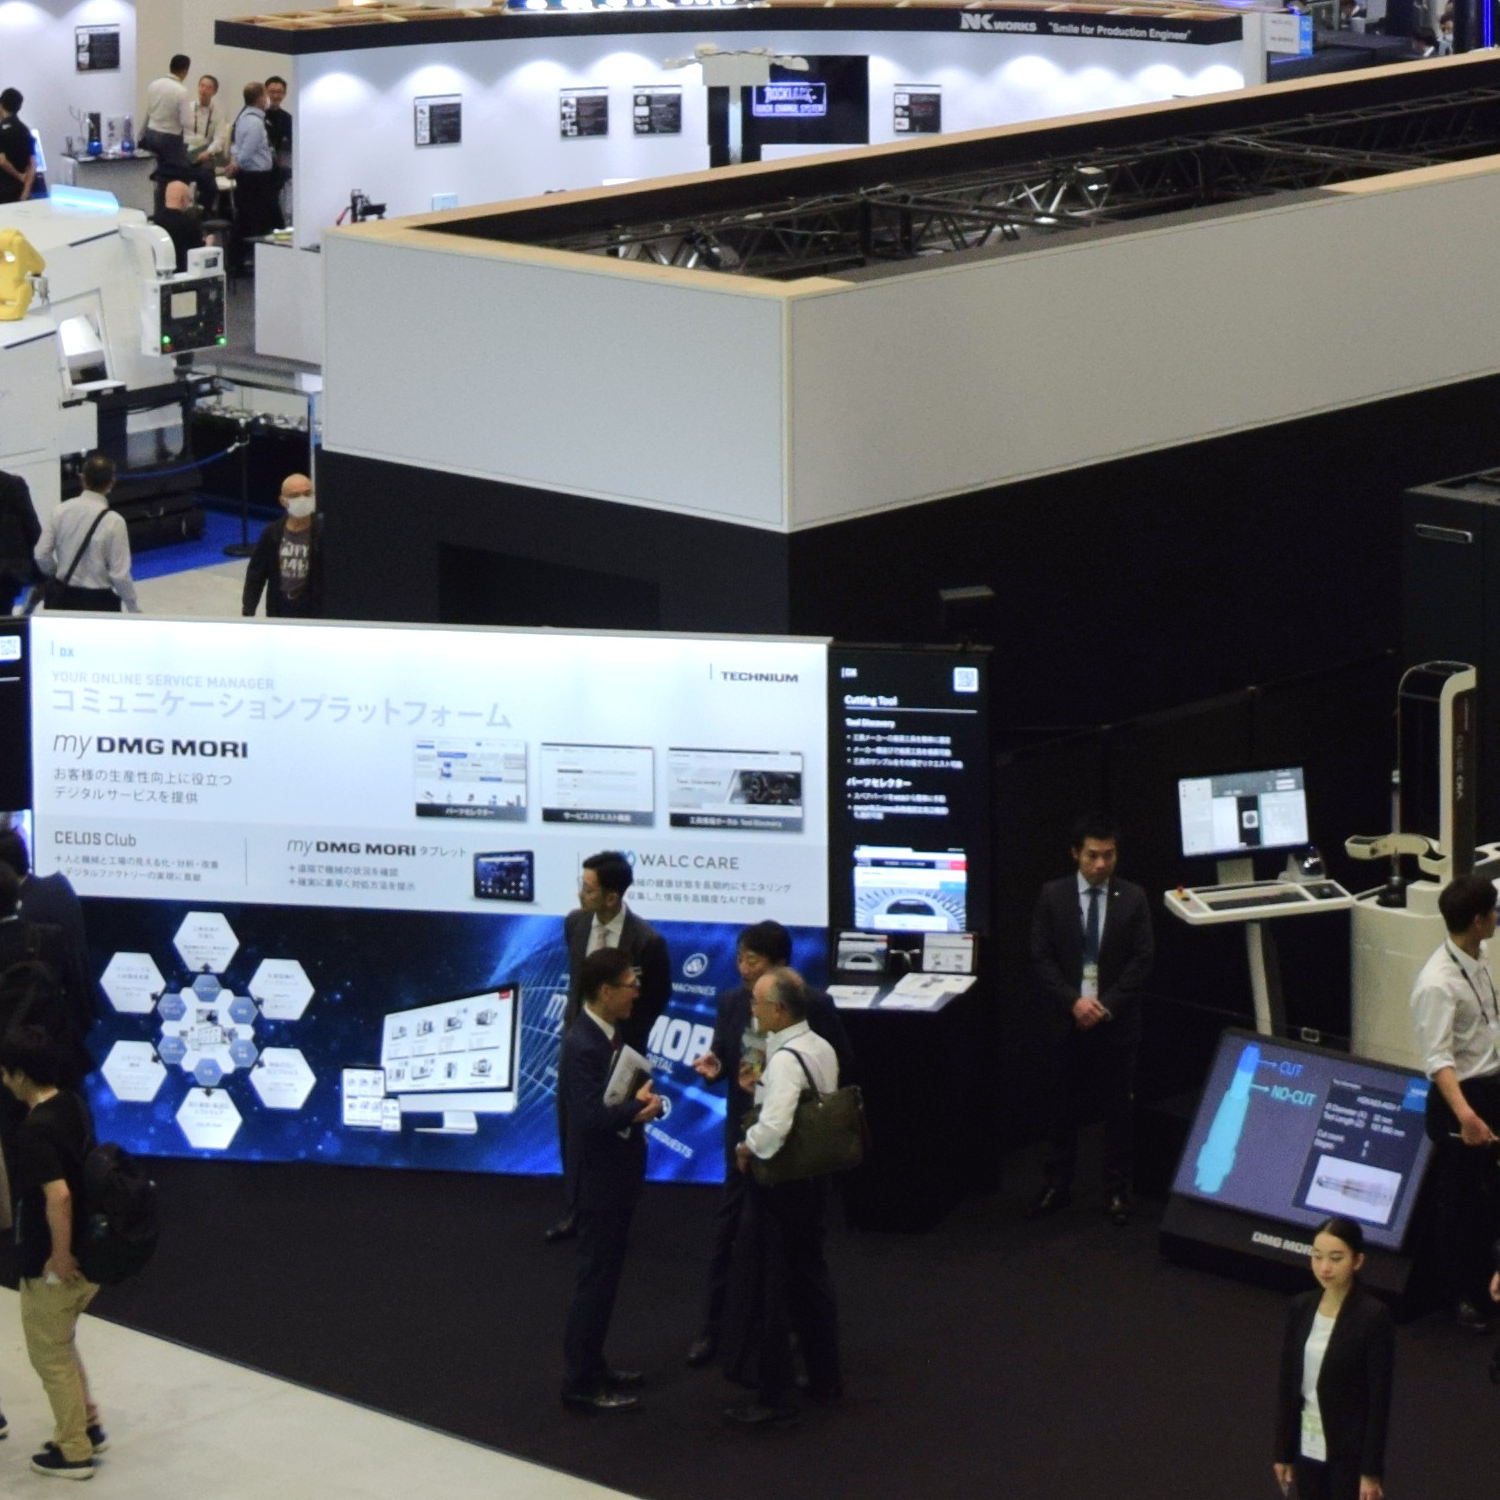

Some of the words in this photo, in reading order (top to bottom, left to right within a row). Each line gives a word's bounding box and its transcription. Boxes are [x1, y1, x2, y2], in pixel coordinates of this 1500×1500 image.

[994, 20, 1038, 33] WORKS
[1081, 23, 1095, 36] for
[1097, 24, 1147, 38] Production
[59, 646, 75, 658] DX
[51, 670, 88, 685] YOUR
[91, 671, 141, 687] ONLINE
[145, 673, 203, 689] SERVICE
[206, 675, 276, 691] MANAGER
[720, 670, 800, 683] TECHNIUM
[52, 687, 512, 730] コミュニケーションプラットフォーム
[843, 694, 878, 708] Cutting
[877, 695, 899, 707] Tool
[52, 733, 93, 760] my
[96, 735, 165, 756] DMG
[171, 739, 248, 759] MORI
[54, 768, 232, 787] お客様の生産性向上に役立つ
[54, 785, 198, 805] デジタルサービスを提供
[104, 832, 137, 848] Club
[287, 839, 312, 857] my
[315, 840, 361, 855] DMG
[365, 842, 417, 858] MORI
[419, 845, 467, 858] タブレット
[639, 853, 690, 869] WALC
[693, 855, 740, 870] CARE
[670, 981, 716, 997] MACHINES
[1278, 1060, 1305, 1078] CUT
[1270, 1084, 1316, 1106] NO-CUT
[1251, 1230, 1282, 1249] DMG
